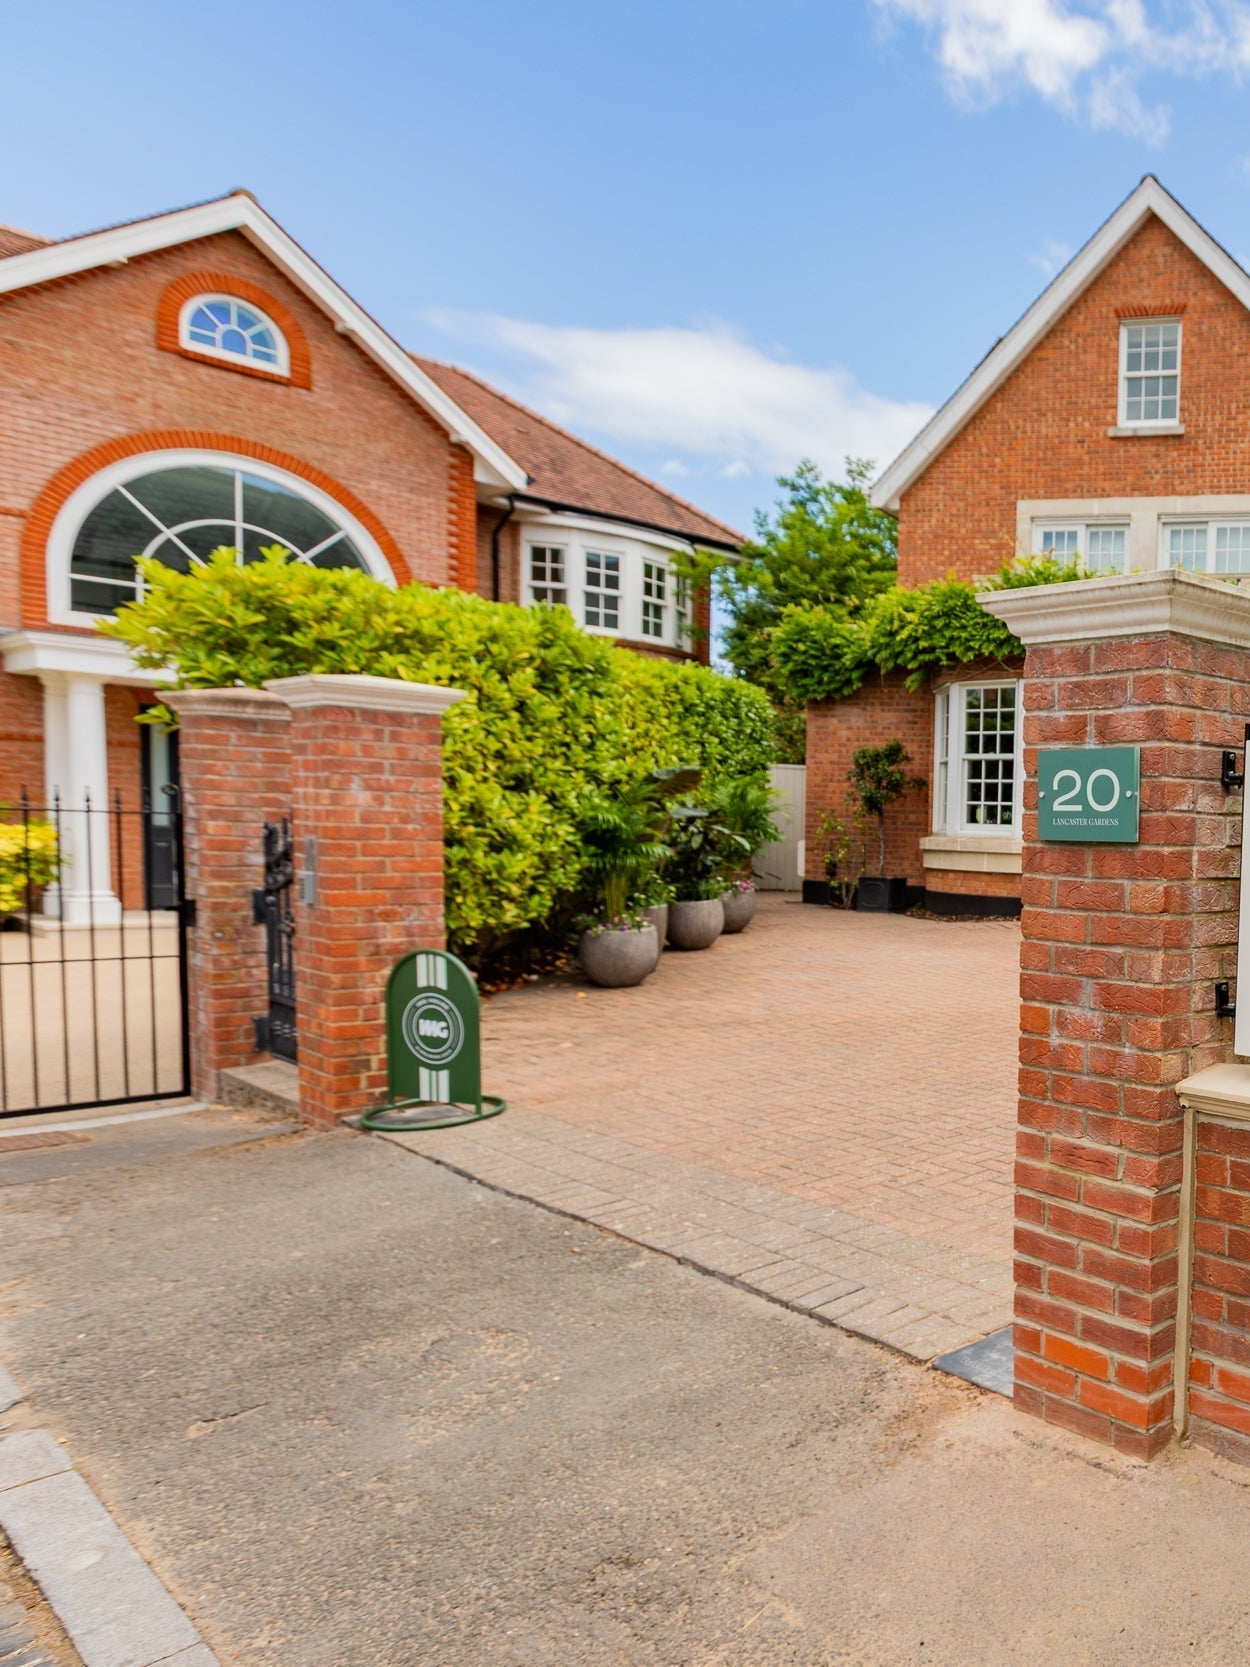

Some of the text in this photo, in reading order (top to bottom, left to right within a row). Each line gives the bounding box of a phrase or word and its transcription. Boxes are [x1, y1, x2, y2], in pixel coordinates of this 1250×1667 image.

[1052, 768, 1120, 812] 20
[1052, 817, 1119, 826] LANCASTER GARDENS
